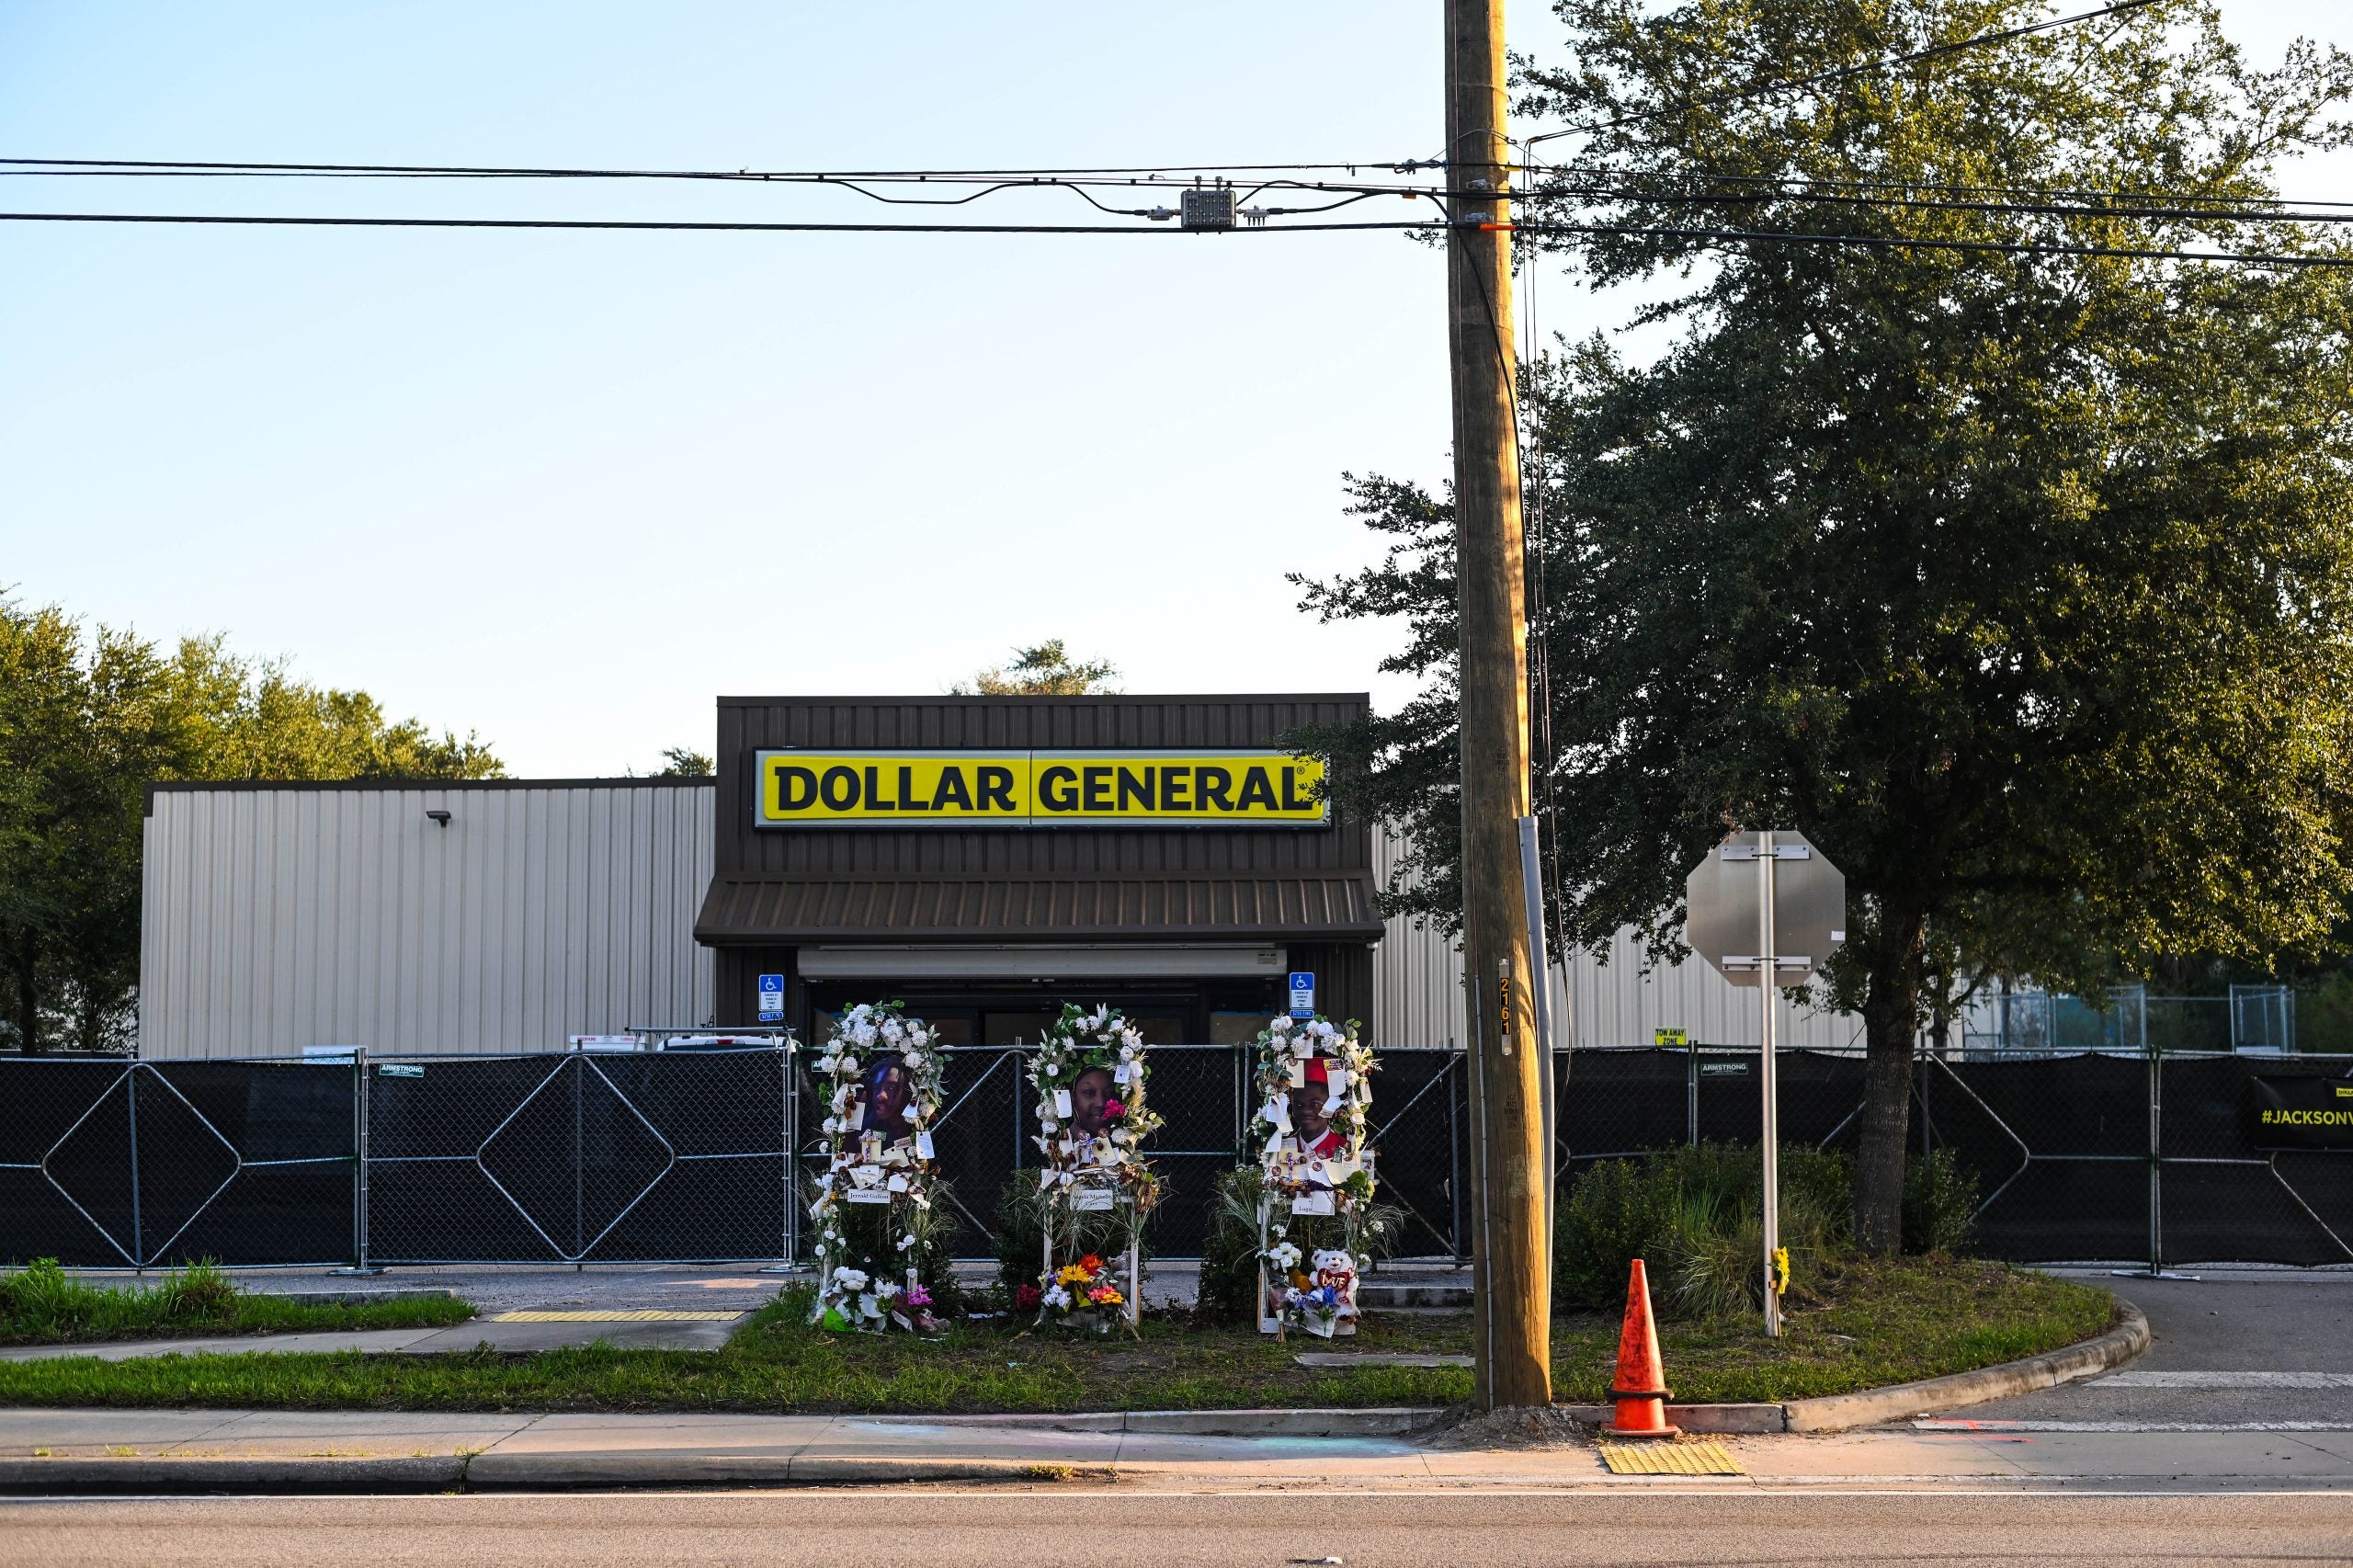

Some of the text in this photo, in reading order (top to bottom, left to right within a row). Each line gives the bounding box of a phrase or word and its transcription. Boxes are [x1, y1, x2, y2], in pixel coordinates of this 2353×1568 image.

[775, 766, 1313, 811] DOLLAR GENERAL
[1501, 978, 1510, 1035] 2161
[381, 1064, 423, 1073] ARMSTRONG
